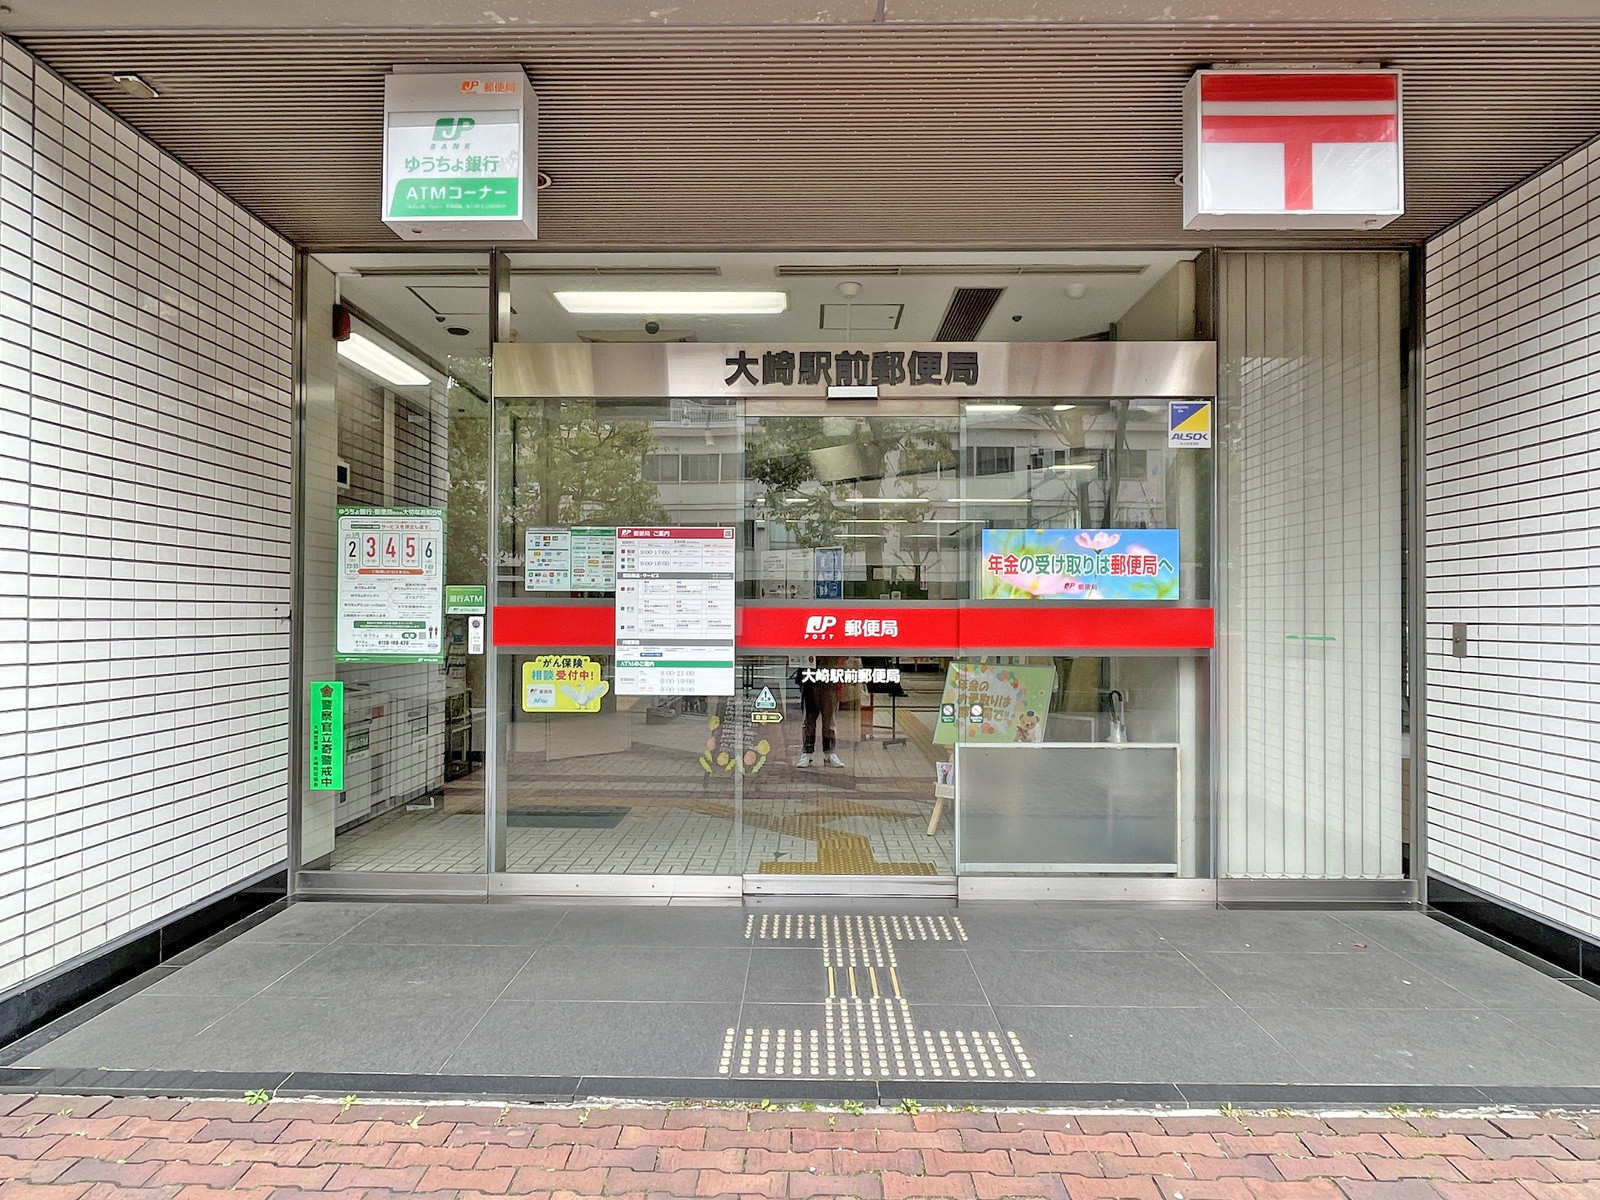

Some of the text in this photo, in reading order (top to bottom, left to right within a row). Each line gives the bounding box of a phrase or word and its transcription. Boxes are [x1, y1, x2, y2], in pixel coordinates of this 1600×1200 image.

[461, 80, 480, 91] JP
[432, 118, 476, 141] JP
[404, 156, 500, 172] ゆうちょ銀行
[406, 185, 508, 200] ATMコーナー
[724, 350, 979, 386] 大崎駅前郵便局
[349, 541, 356, 558] 2
[366, 537, 376, 558] 3
[386, 537, 396, 558] 4
[406, 537, 416, 558] 5
[426, 542, 432, 558] 6
[988, 554, 1174, 575] 年金の受け取りは郵便局へ
[806, 616, 898, 637] JP 郵便局
[802, 668, 901, 683] 大崎駅前郵便局
